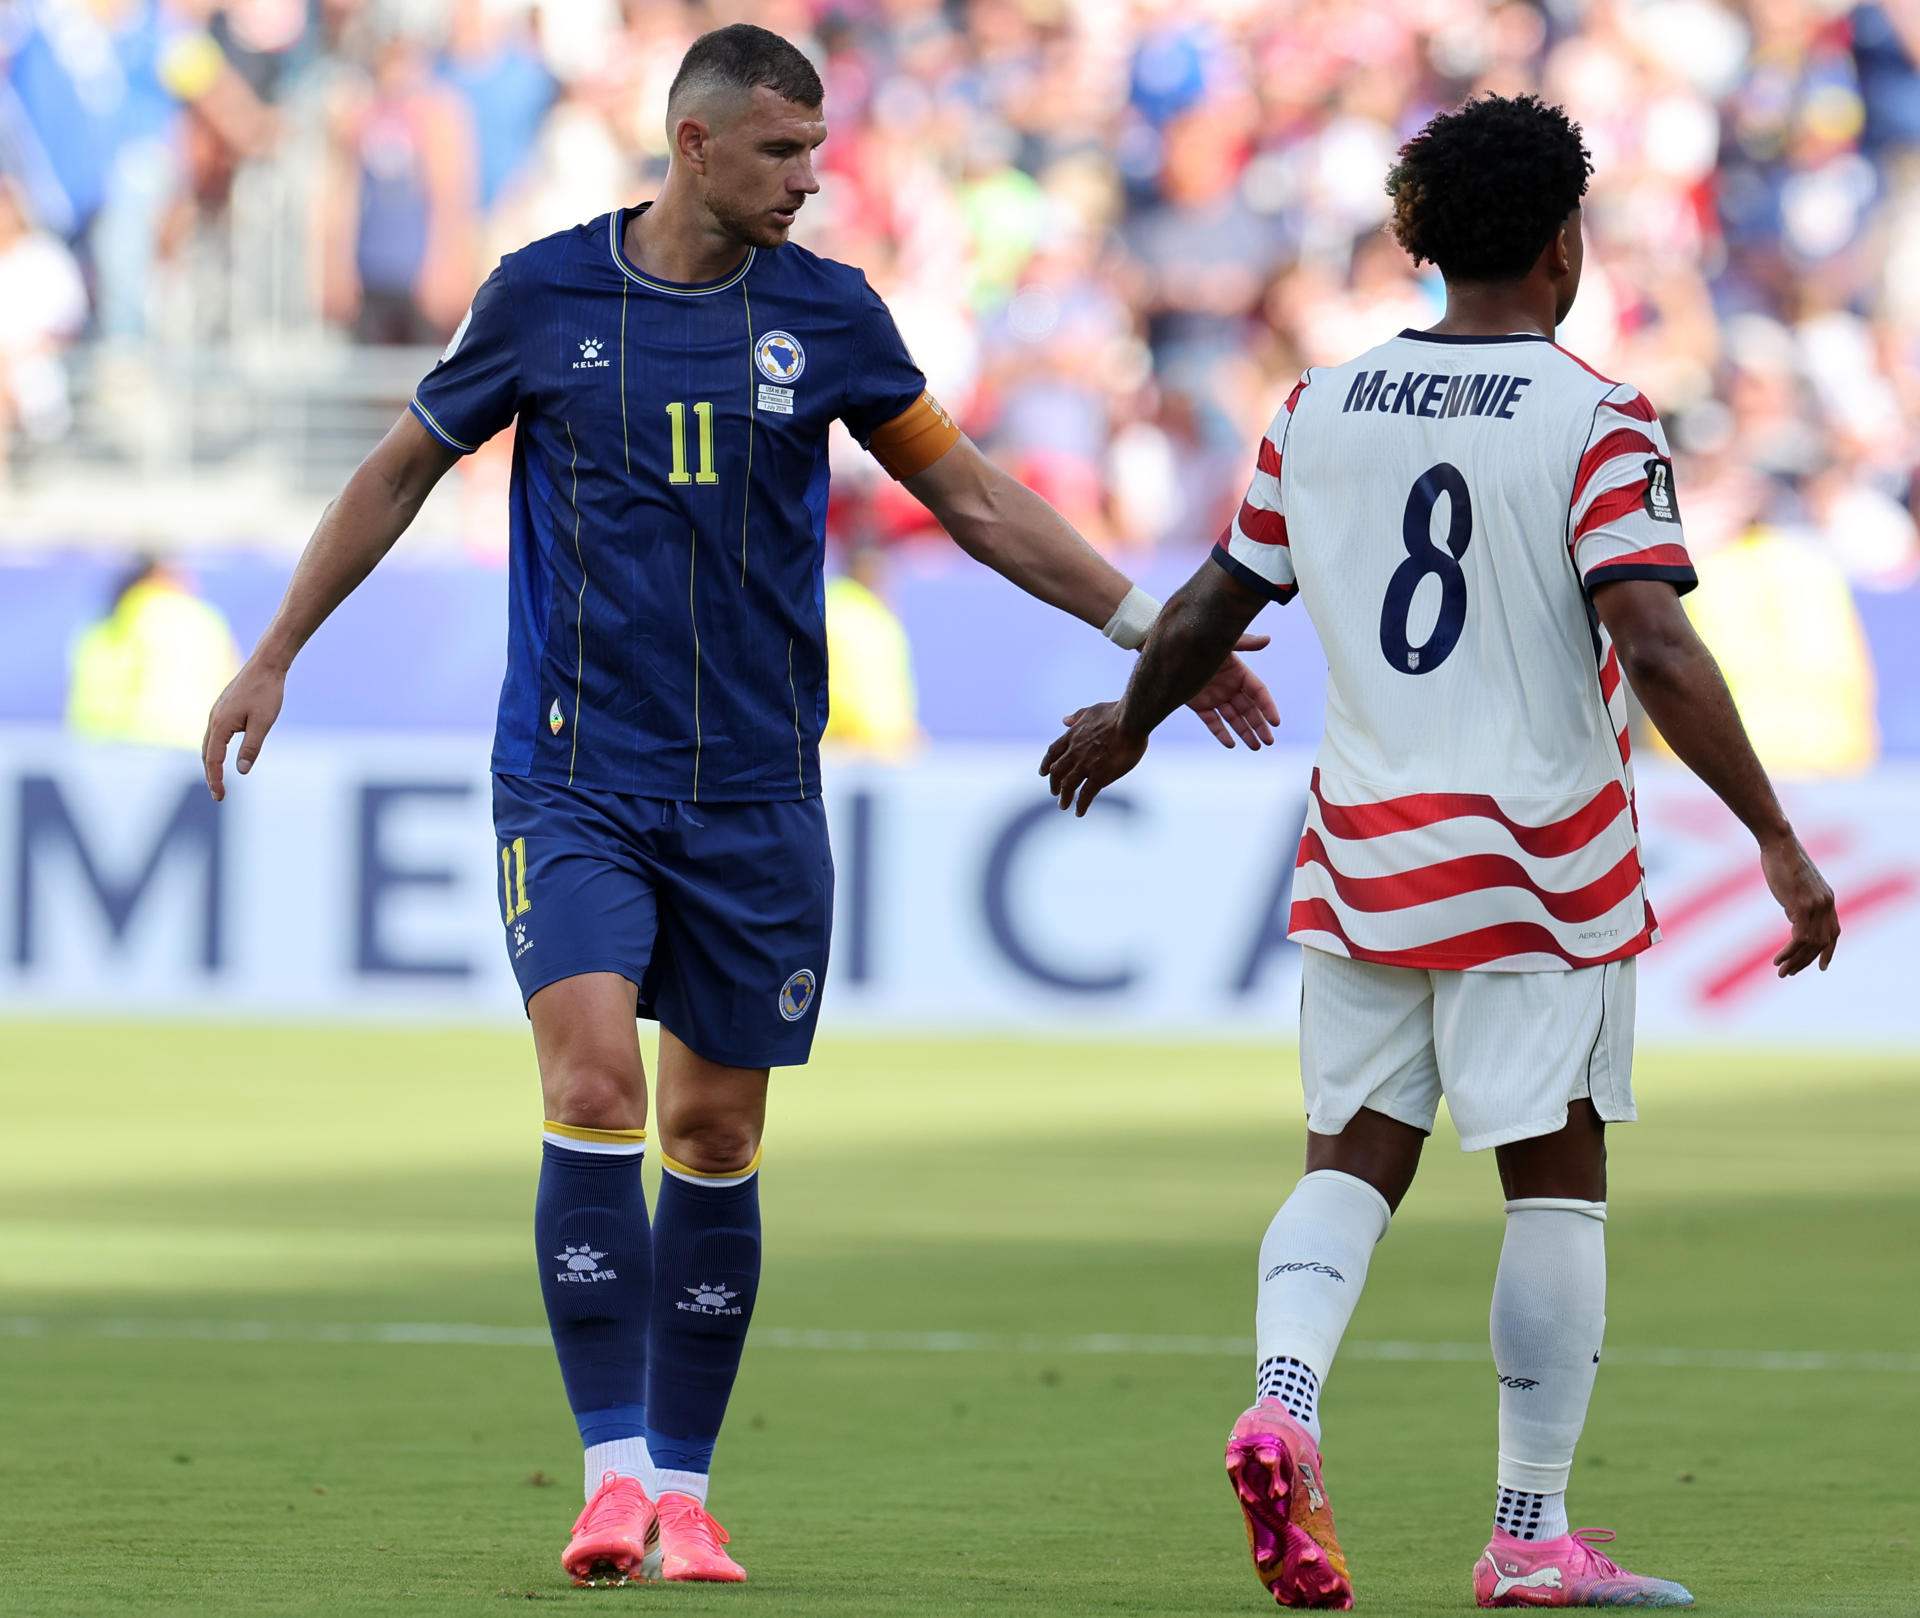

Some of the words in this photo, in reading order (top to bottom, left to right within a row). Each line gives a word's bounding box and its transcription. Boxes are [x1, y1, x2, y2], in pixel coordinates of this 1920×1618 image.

[572, 359, 610, 369] KELME
[1342, 369, 1533, 420] McKENNIE
[665, 401, 719, 485] 11
[1380, 462, 1473, 676] 8
[502, 837, 531, 926] 11
[515, 940, 535, 959] KELME
[557, 1269, 618, 1283] KELME
[676, 1301, 742, 1316] KELME
